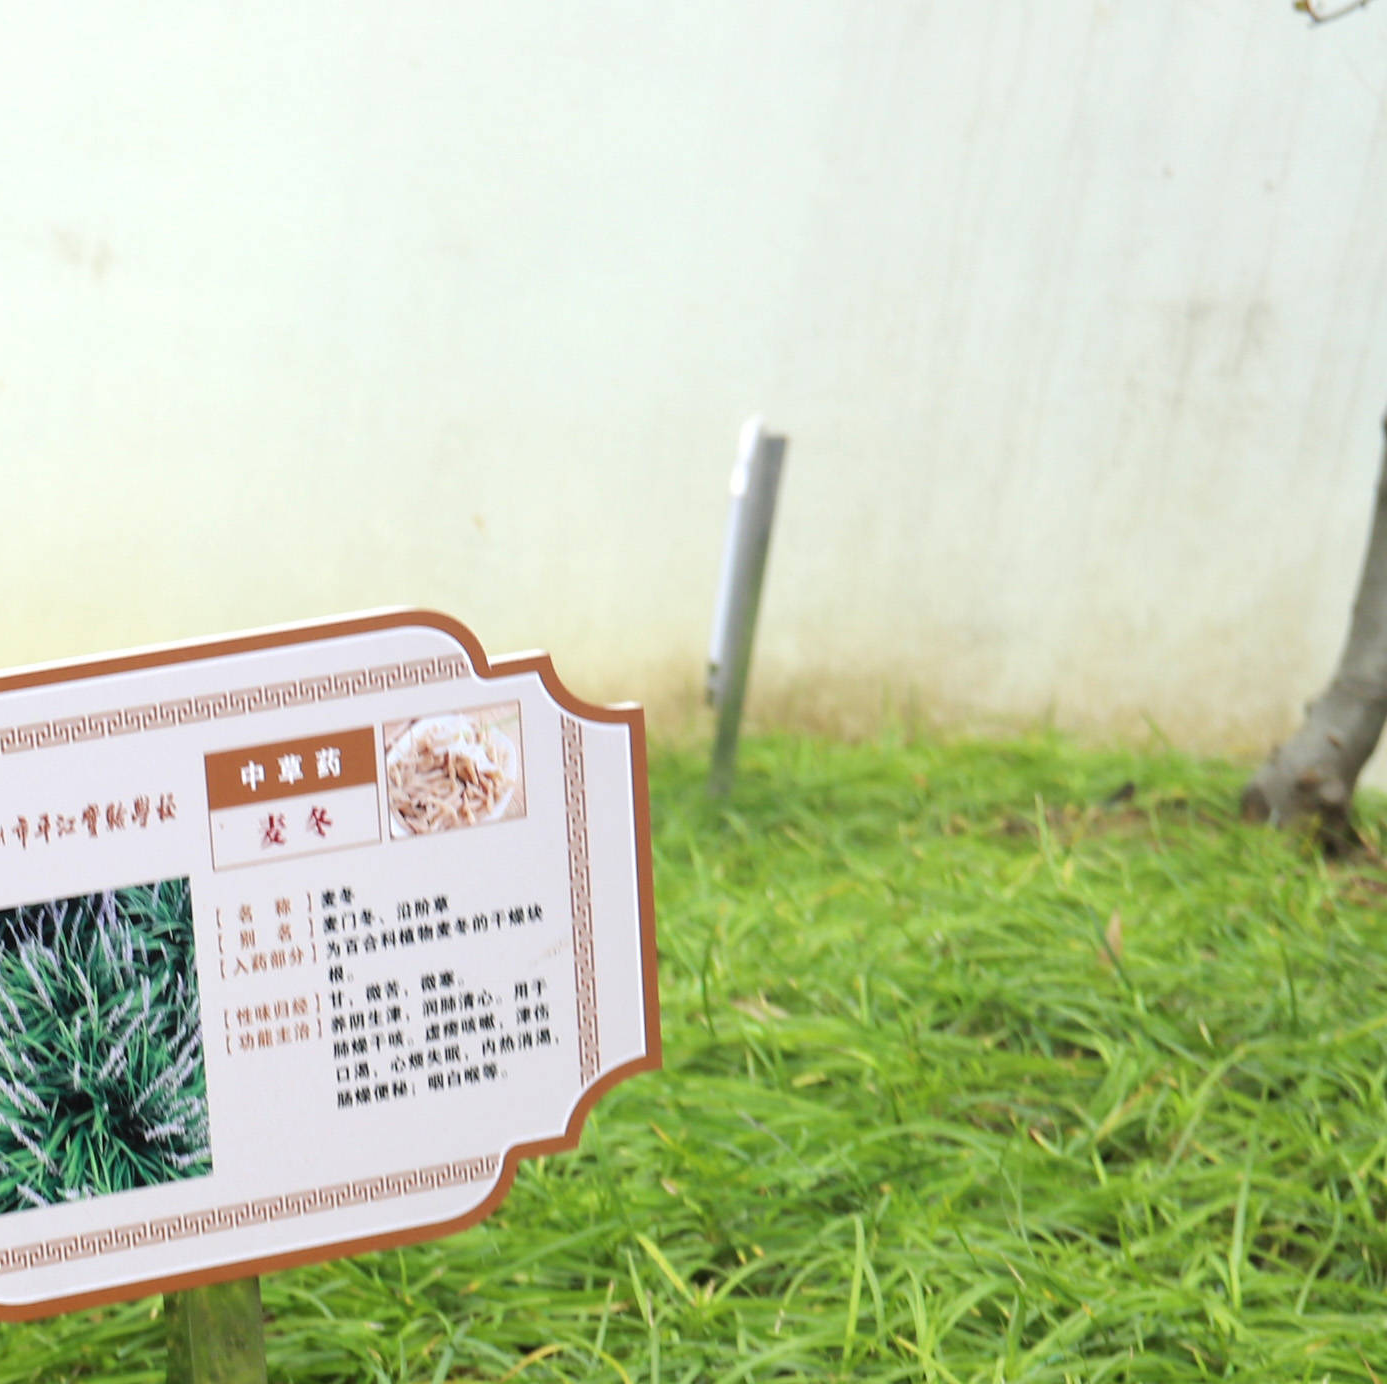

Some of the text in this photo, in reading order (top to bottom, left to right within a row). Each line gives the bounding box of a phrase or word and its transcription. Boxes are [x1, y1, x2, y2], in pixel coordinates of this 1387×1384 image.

[240, 746, 342, 792] 中草药
[260, 805, 333, 850] 麦冬
[322, 885, 355, 909] 麦冬
